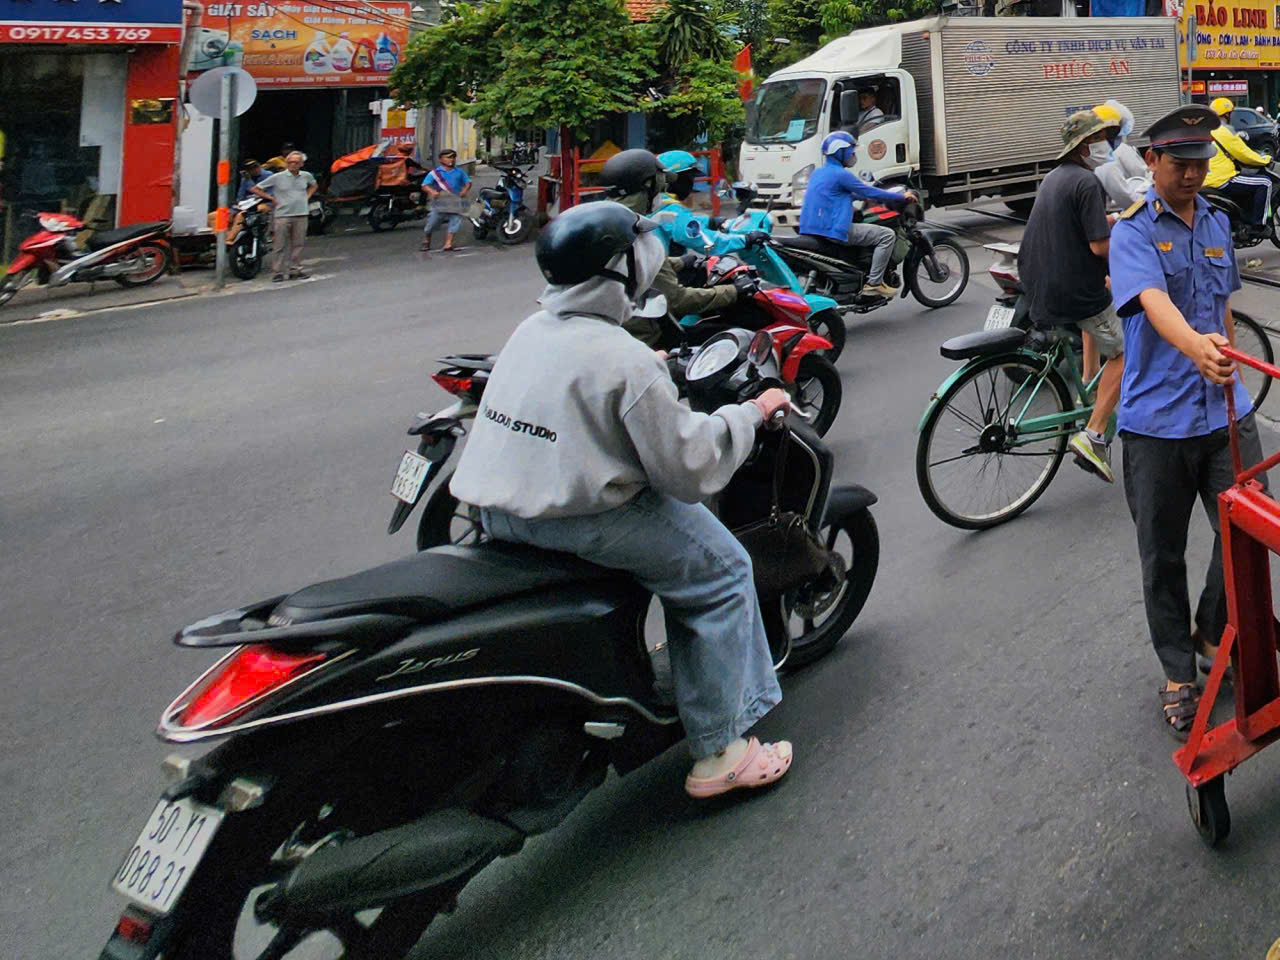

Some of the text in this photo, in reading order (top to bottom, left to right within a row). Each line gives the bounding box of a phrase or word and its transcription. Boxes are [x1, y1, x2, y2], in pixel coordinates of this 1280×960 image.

[1232, 8, 1268, 29] LINH
[114, 28, 151, 40] 769
[252, 29, 297, 43] SẠCH
[1042, 58, 1094, 80] PHÚC
[512, 420, 557, 442] STUDIO
